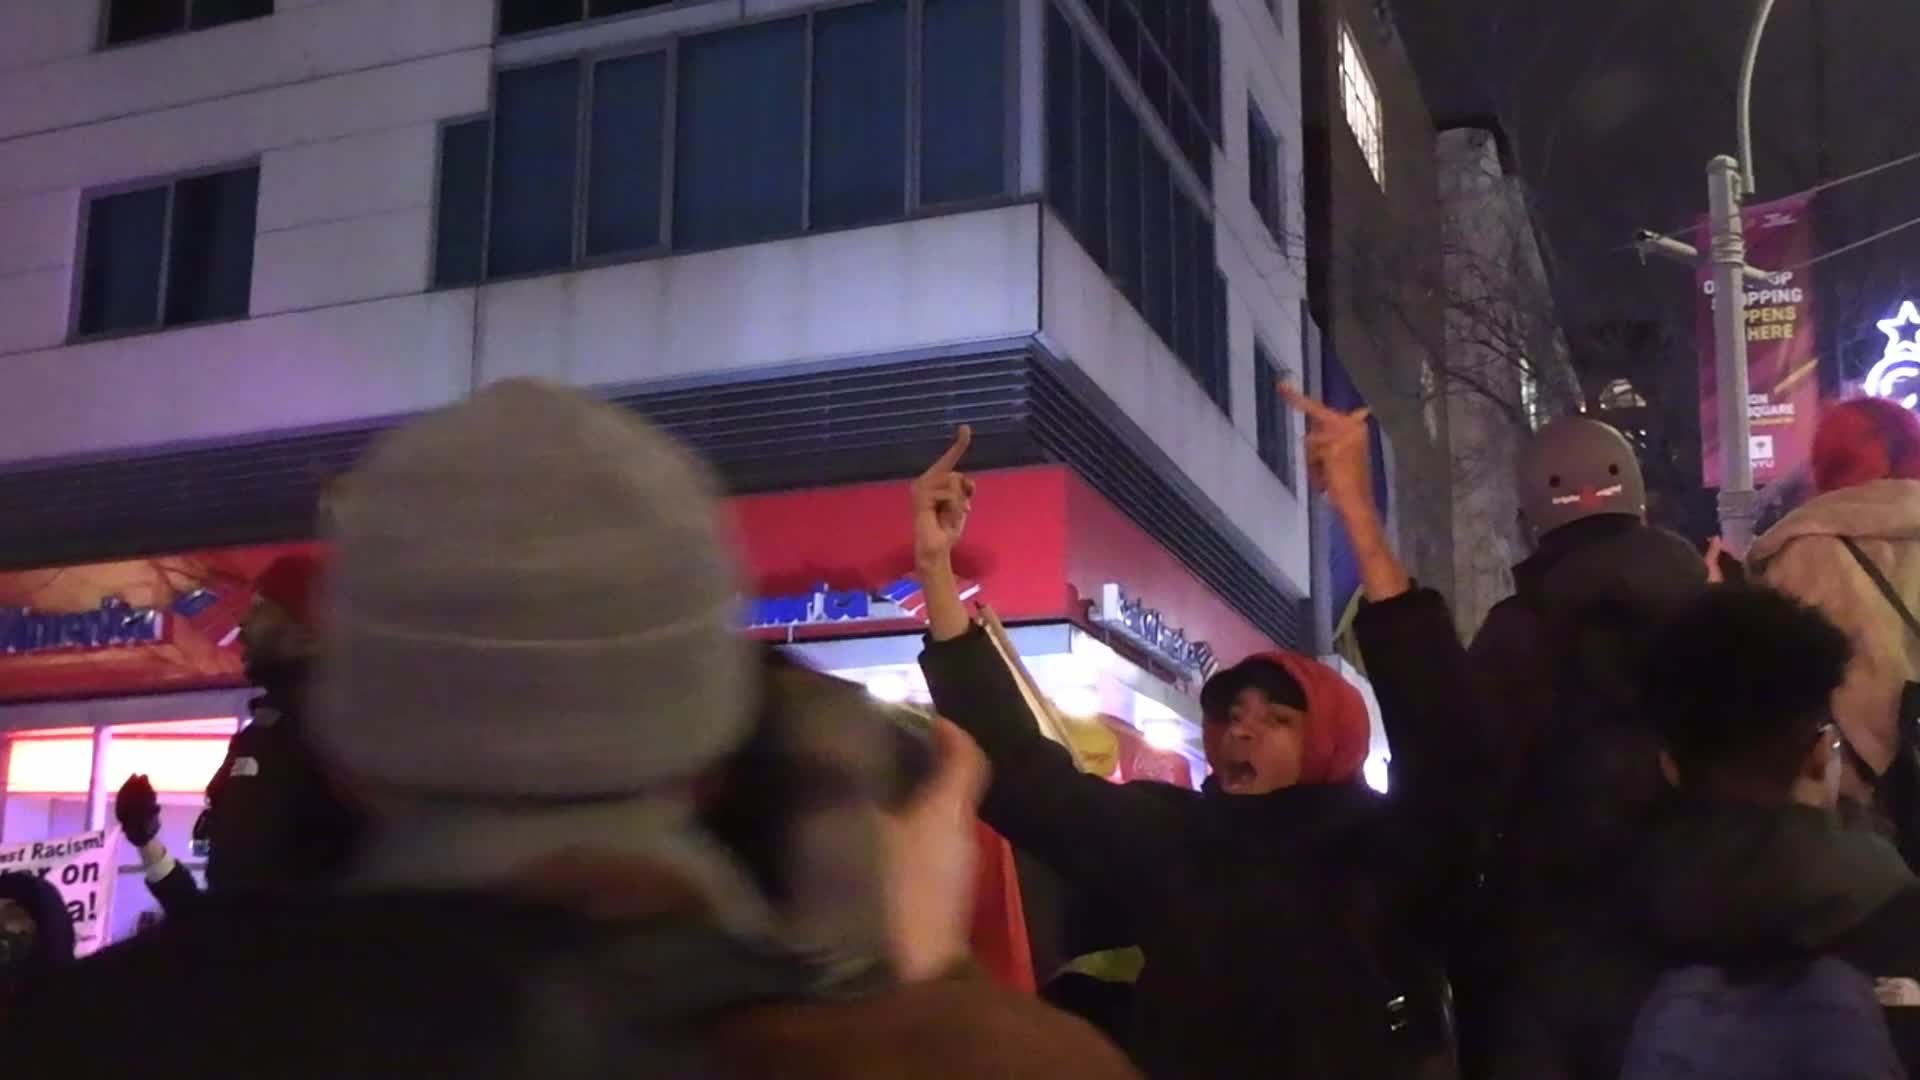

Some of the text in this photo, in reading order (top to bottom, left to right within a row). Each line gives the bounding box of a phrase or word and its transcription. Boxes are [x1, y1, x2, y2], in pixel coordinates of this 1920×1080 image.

[1747, 323, 1793, 341] HERE
[31, 831, 105, 860] Racism!
[61, 861, 99, 885] on
